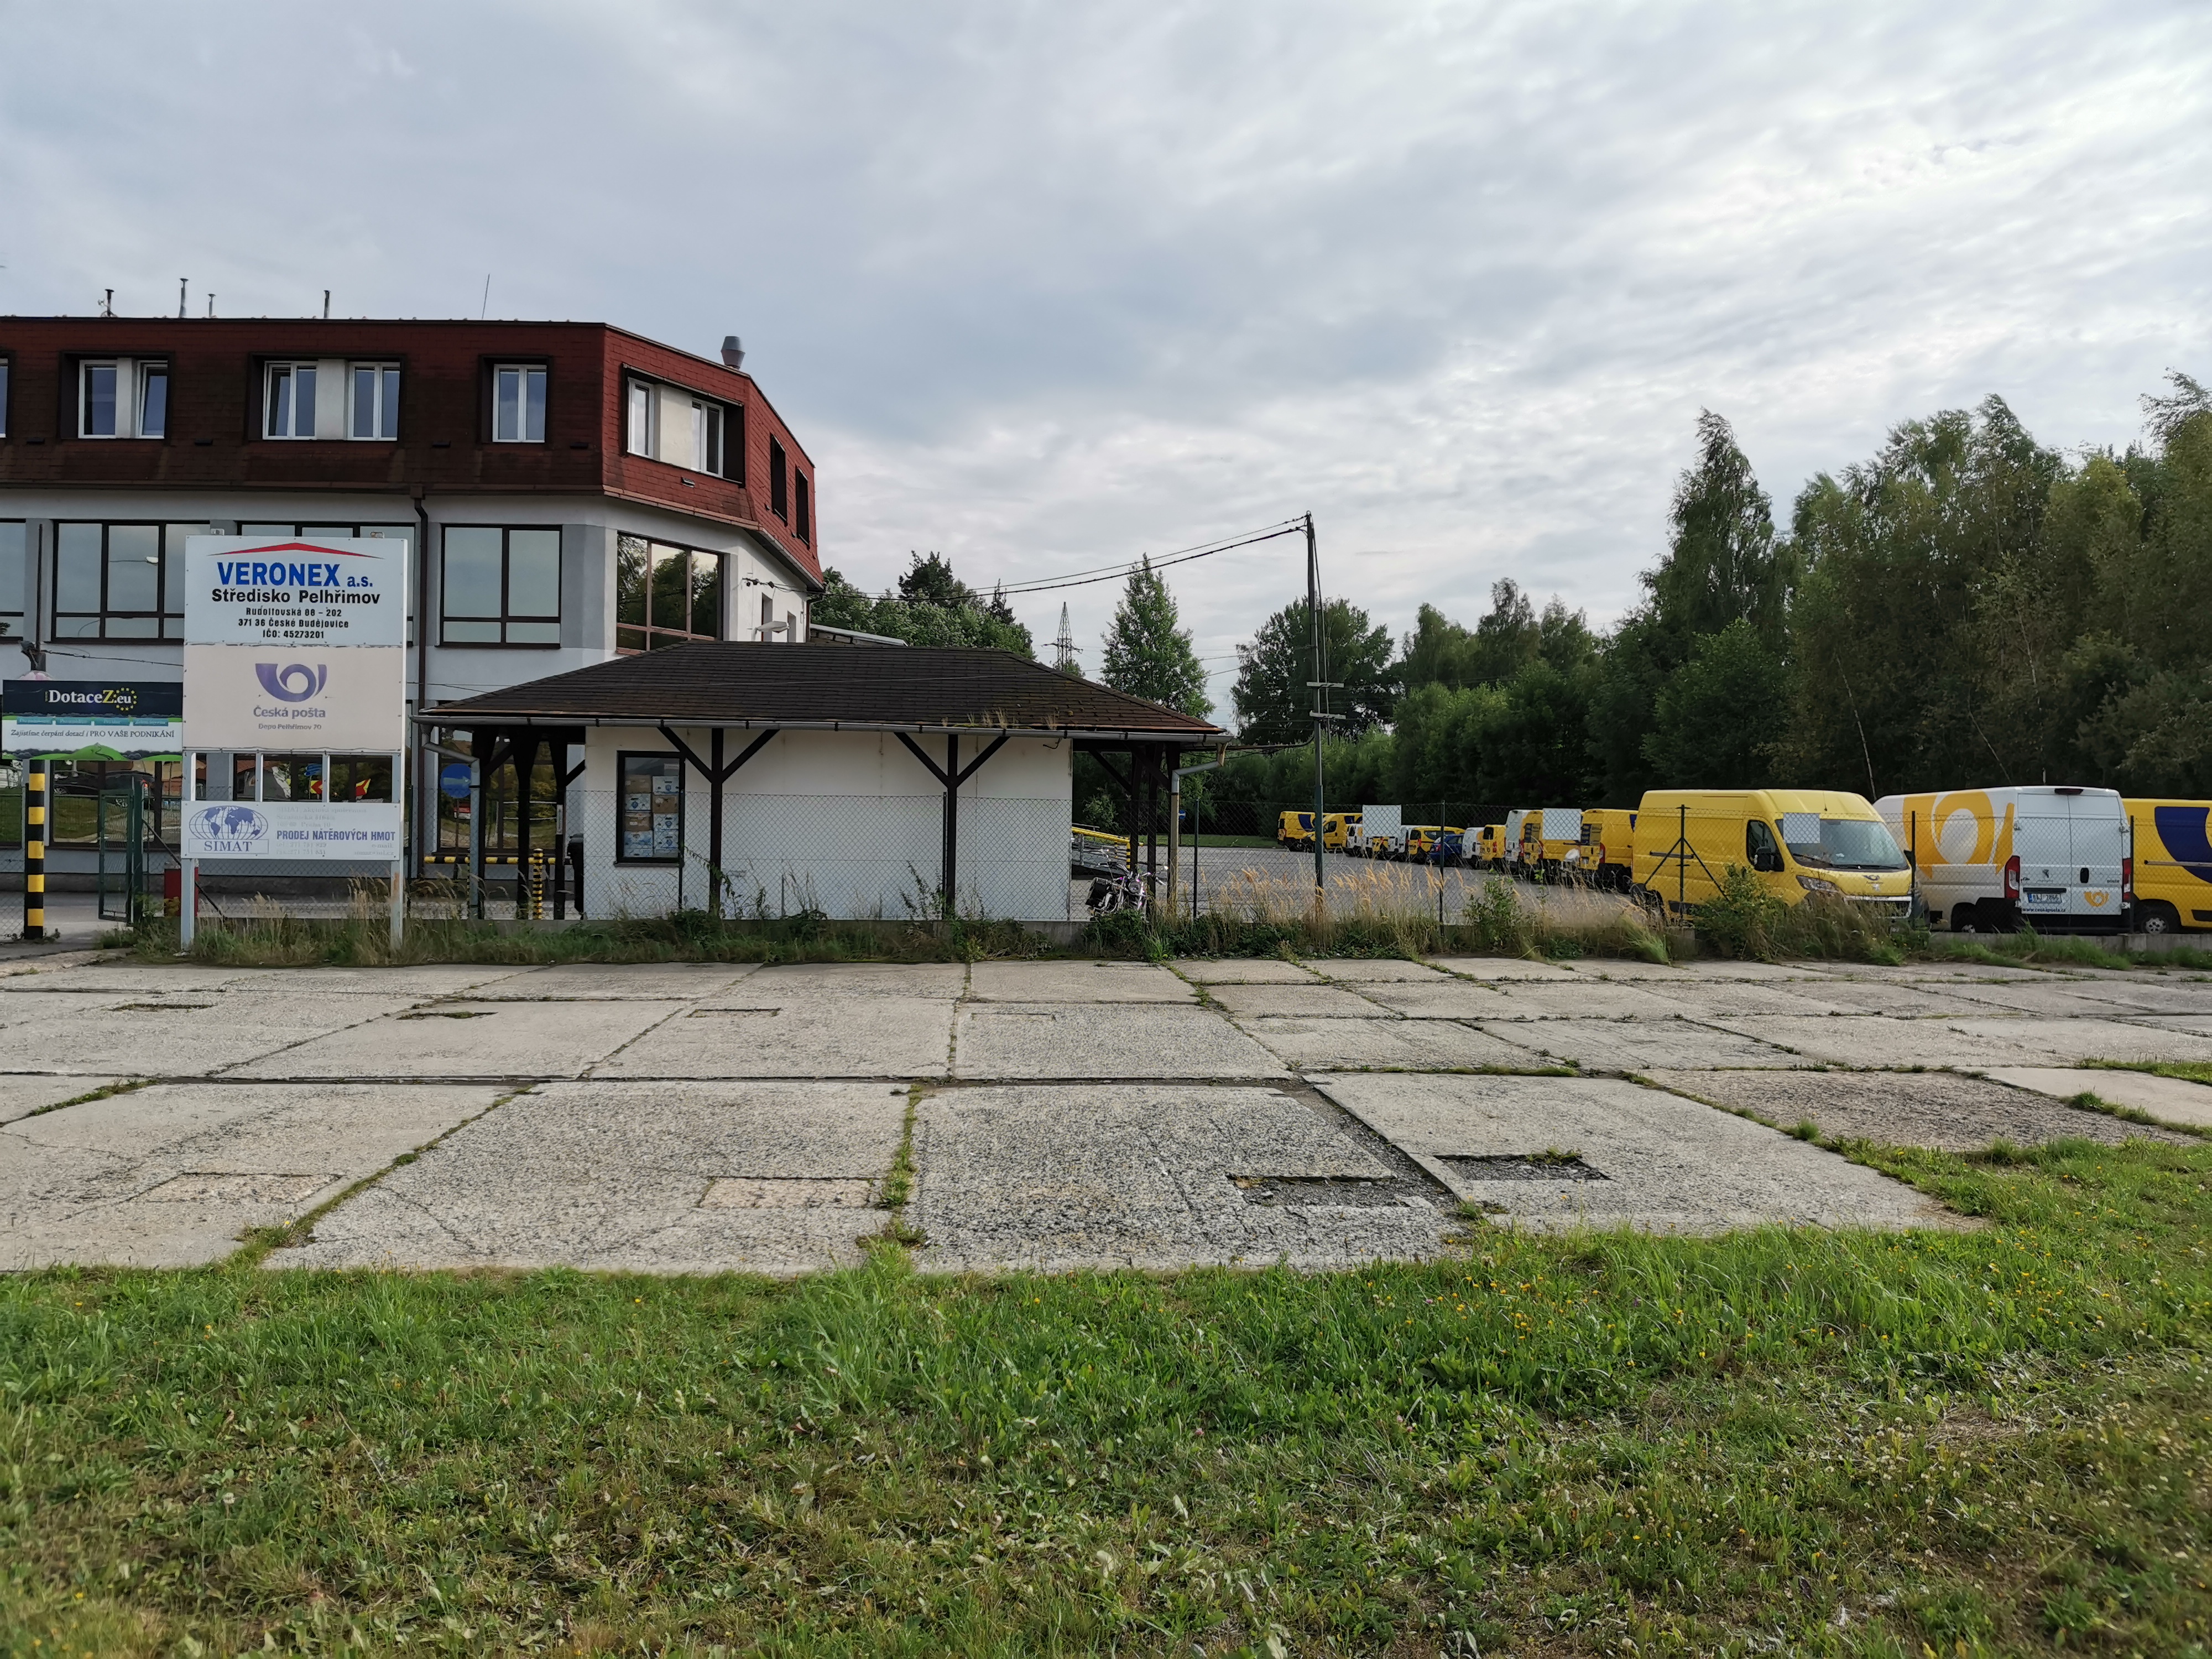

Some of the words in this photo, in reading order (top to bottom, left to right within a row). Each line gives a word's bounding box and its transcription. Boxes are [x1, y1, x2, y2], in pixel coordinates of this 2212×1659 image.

[217, 562, 341, 587] VERONEX
[347, 576, 373, 587] a.s.
[212, 588, 290, 603] Středisko
[299, 589, 380, 604] Pelhřimov
[246, 608, 301, 616] Rudolfovská
[269, 618, 295, 627] České
[299, 619, 348, 628] Budějovice
[283, 630, 324, 639] 45273201
[253, 705, 289, 717] Česká
[292, 708, 326, 719] pošta
[41, 729, 64, 738] čerpání
[277, 831, 309, 841] PRODEJ
[312, 828, 368, 841] NÁTĚROVÝCH
[371, 831, 395, 841] HMOT
[204, 841, 252, 852] SIMAT
